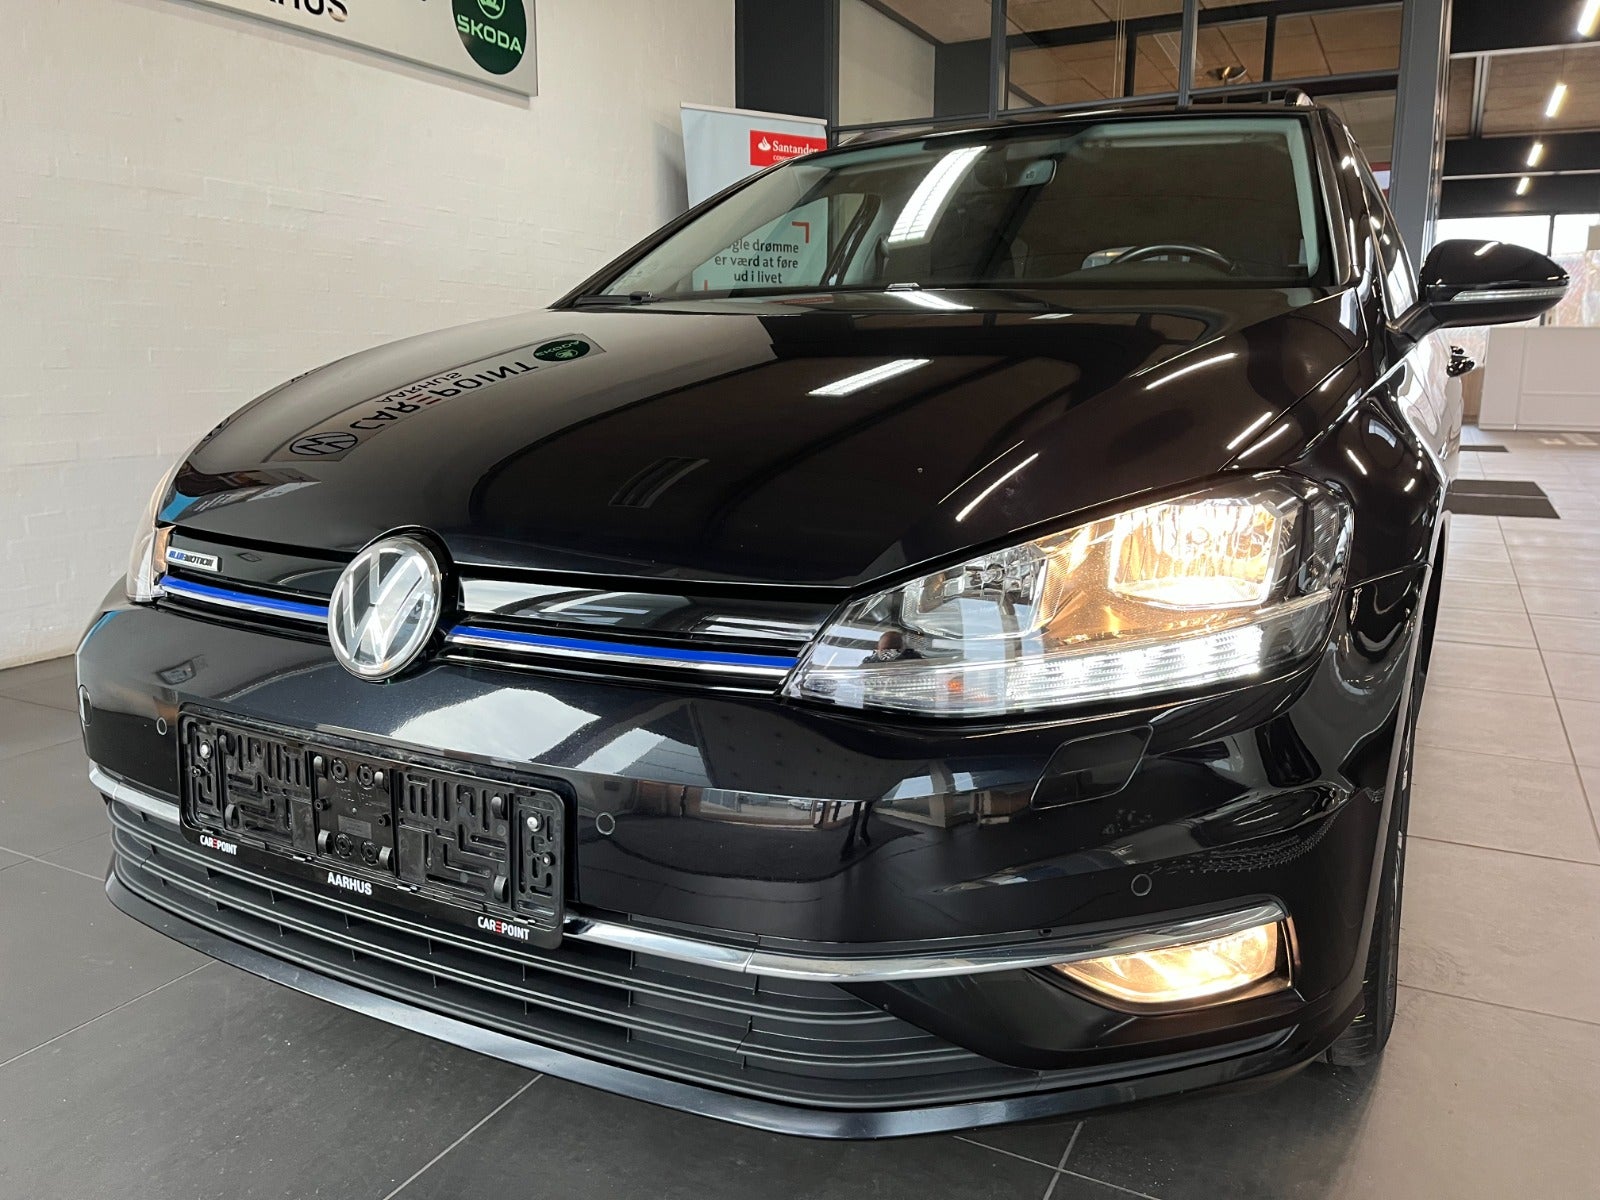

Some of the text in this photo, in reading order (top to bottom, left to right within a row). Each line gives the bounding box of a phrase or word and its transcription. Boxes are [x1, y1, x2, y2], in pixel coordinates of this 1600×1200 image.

[457, 14, 522, 55] SKODA
[772, 140, 819, 154] Santander
[752, 239, 799, 254] drømme
[714, 255, 799, 269] er værd at føre
[734, 270, 748, 282] ud
[757, 270, 783, 284] livet
[327, 871, 373, 896] AARHUS
